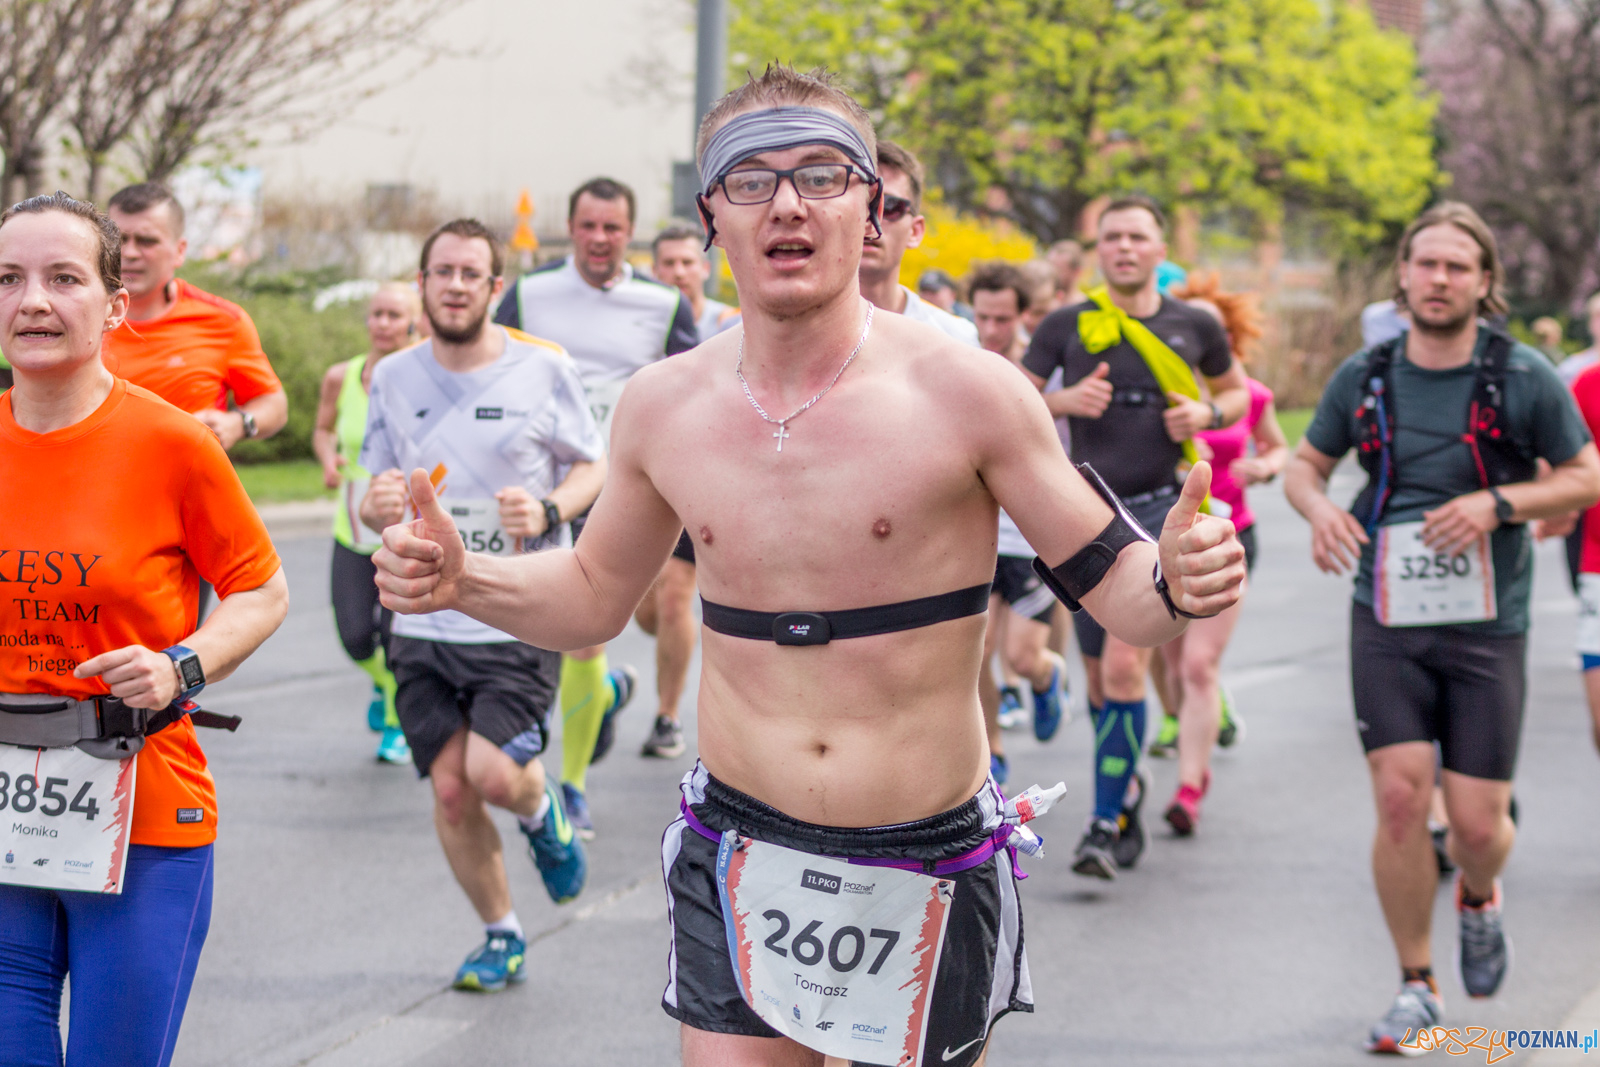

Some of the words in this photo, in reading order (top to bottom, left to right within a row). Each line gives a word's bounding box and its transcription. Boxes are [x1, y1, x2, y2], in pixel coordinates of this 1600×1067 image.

[1399, 553, 1471, 579] 3250
[13, 598, 101, 624] TEAM
[45, 633, 65, 647] na
[12, 822, 58, 838] Monika
[762, 909, 900, 975] 2607
[794, 973, 848, 997] Tomasz
